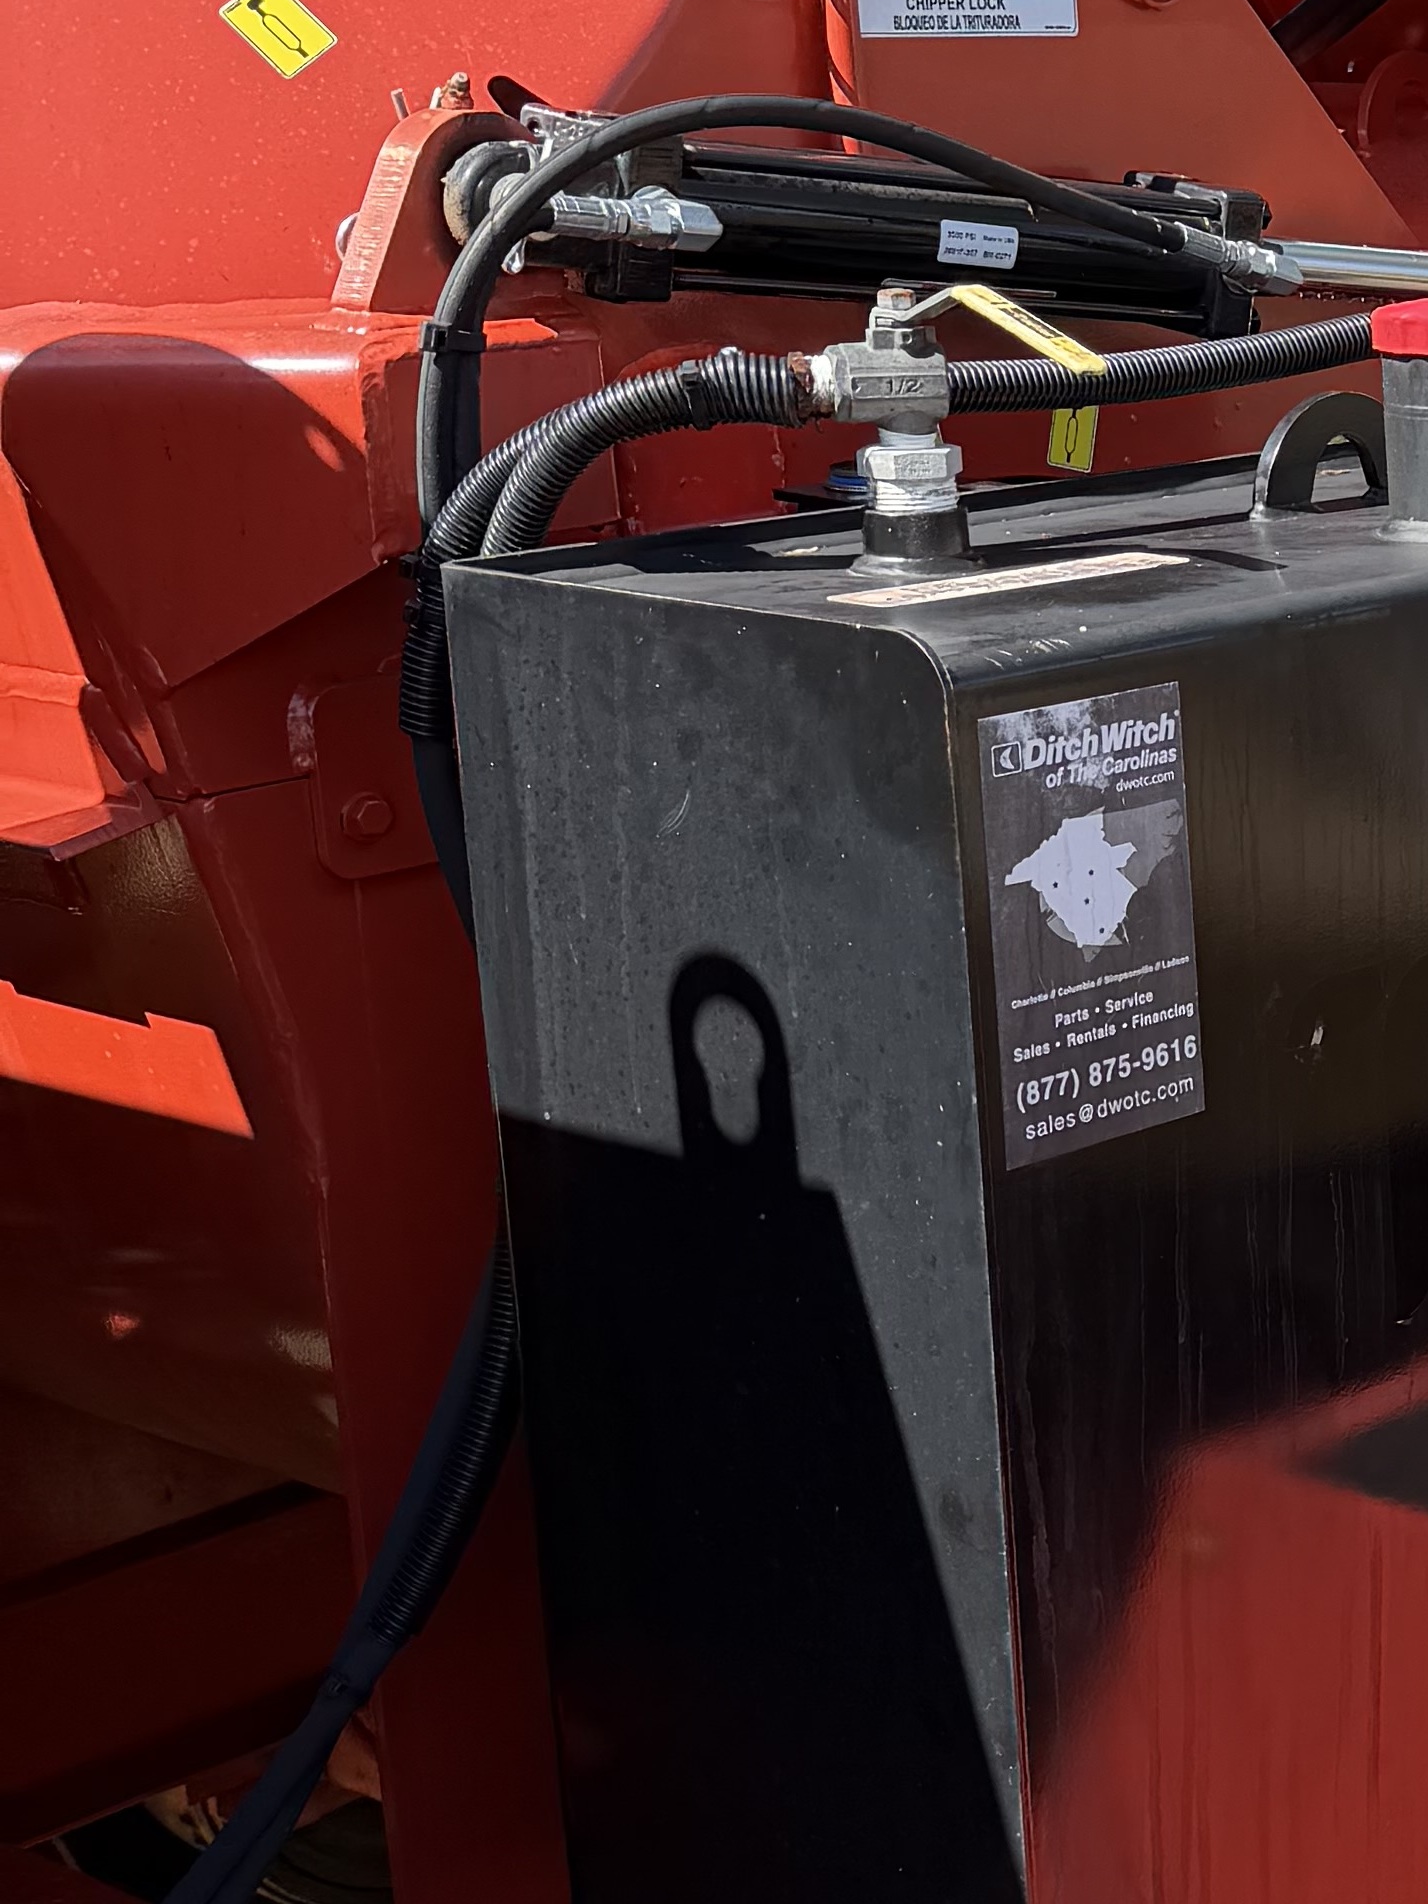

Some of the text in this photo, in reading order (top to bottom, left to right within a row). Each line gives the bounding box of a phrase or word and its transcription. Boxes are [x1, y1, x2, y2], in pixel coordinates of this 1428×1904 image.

[894, 15, 1021, 31] BLOQUEO DE LA TRITURADORA
[886, 378, 922, 396] 1/2
[1024, 712, 1176, 770] Ditch Witch
[1046, 747, 1177, 788] of The Carolinas
[1116, 770, 1175, 793] dwotc.com
[1012, 992, 1049, 1009] Charlotte
[1058, 979, 1096, 996] Columbia
[1054, 990, 1154, 1028] Parts Service
[1014, 1002, 1194, 1063] Sales Rentals Financing
[1016, 1034, 1197, 1114] (877) 875-9616
[1025, 1076, 1194, 1140] sales@dwotc.com
